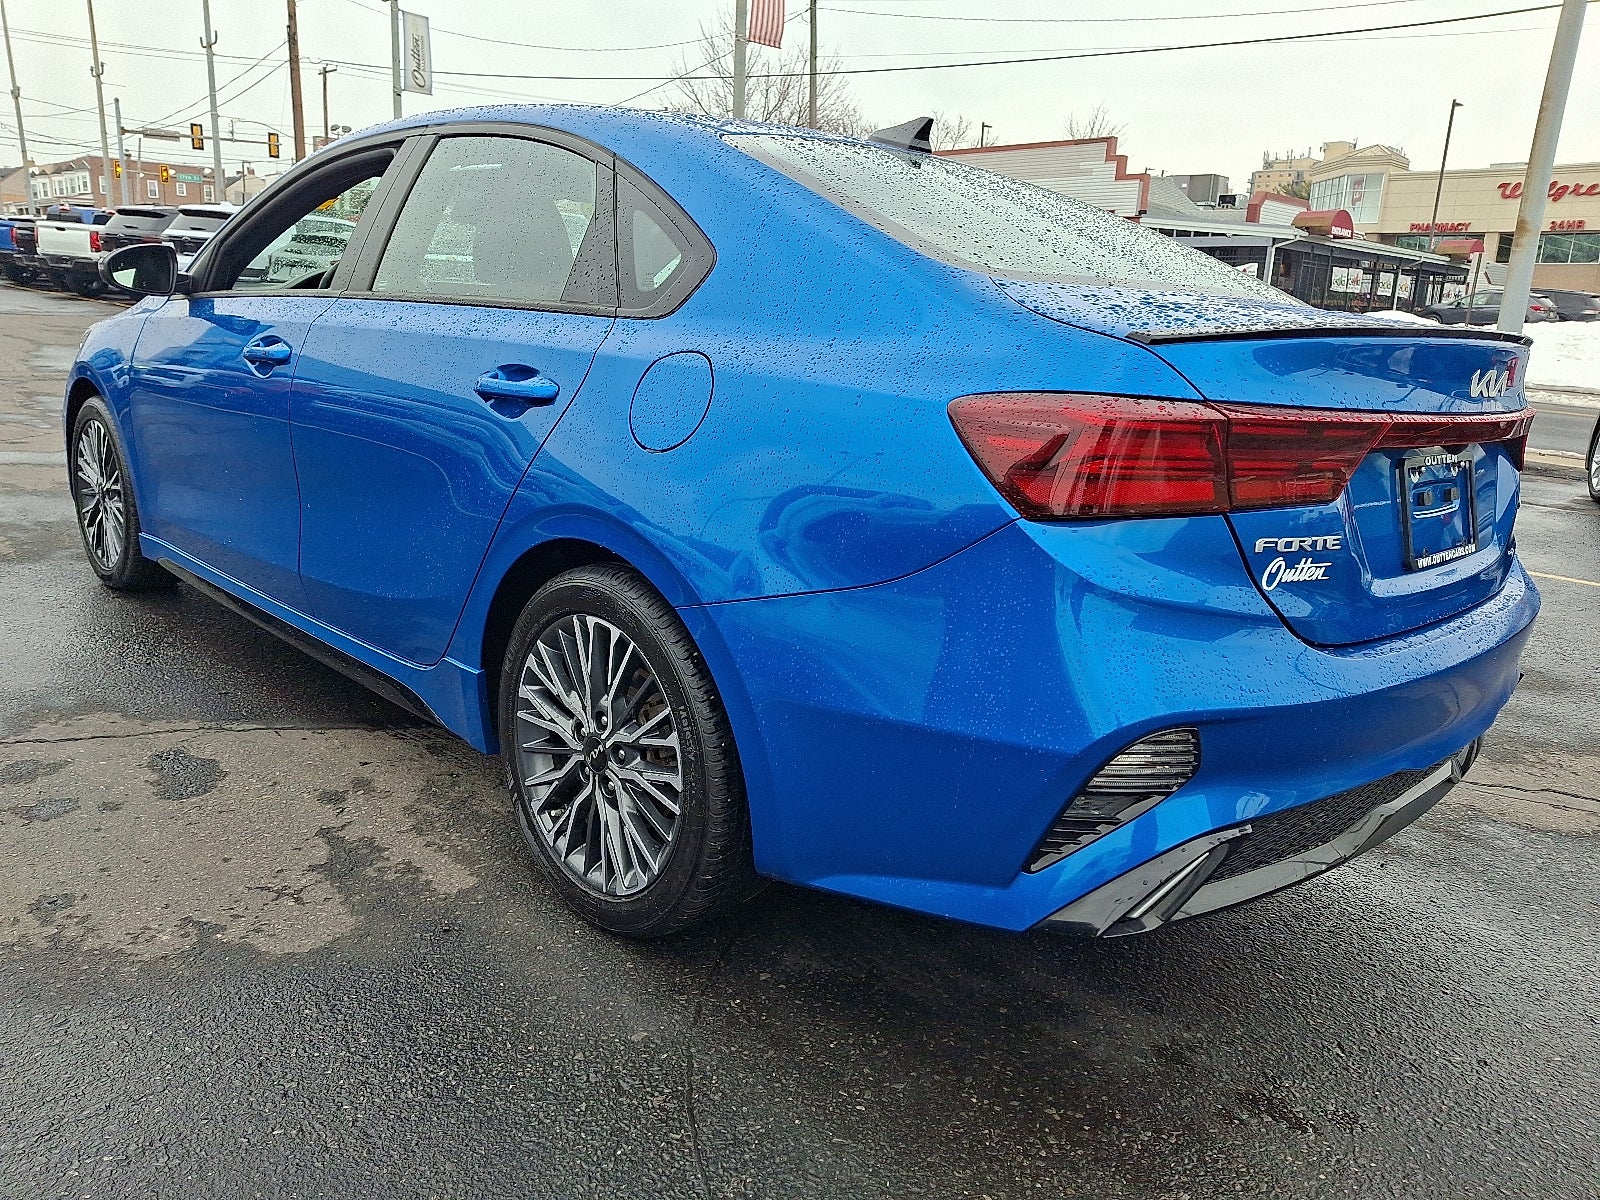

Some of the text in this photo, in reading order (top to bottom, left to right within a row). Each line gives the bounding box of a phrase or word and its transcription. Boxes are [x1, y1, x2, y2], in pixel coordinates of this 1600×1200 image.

[1549, 220, 1585, 231] 24HR
[1424, 454, 1458, 466] OUTTEN
[1254, 535, 1342, 553] FORTE
[1261, 556, 1333, 591] Outten
